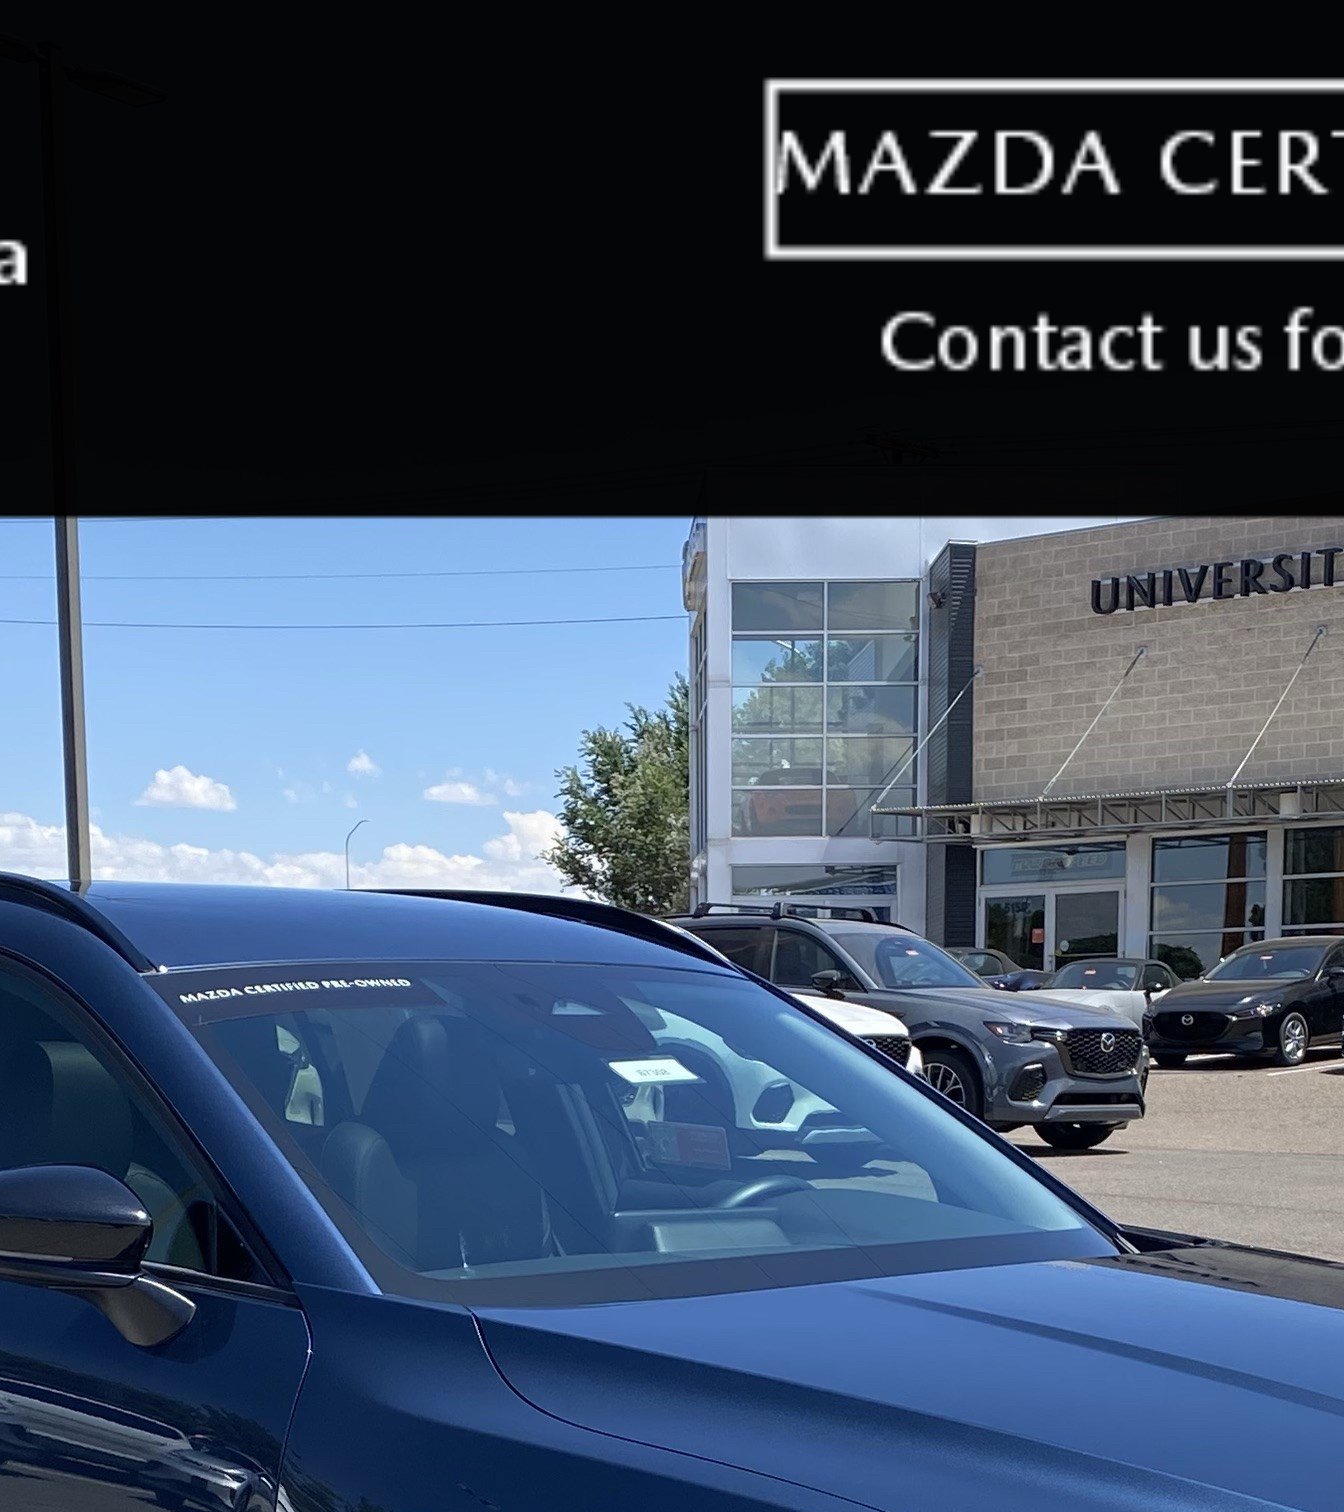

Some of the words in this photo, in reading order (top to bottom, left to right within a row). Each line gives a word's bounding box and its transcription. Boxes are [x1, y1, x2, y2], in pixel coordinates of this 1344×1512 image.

[179, 988, 244, 1004] MAZDA
[243, 981, 320, 996] CERTIFIED
[321, 979, 412, 989] PRE-OWNED
